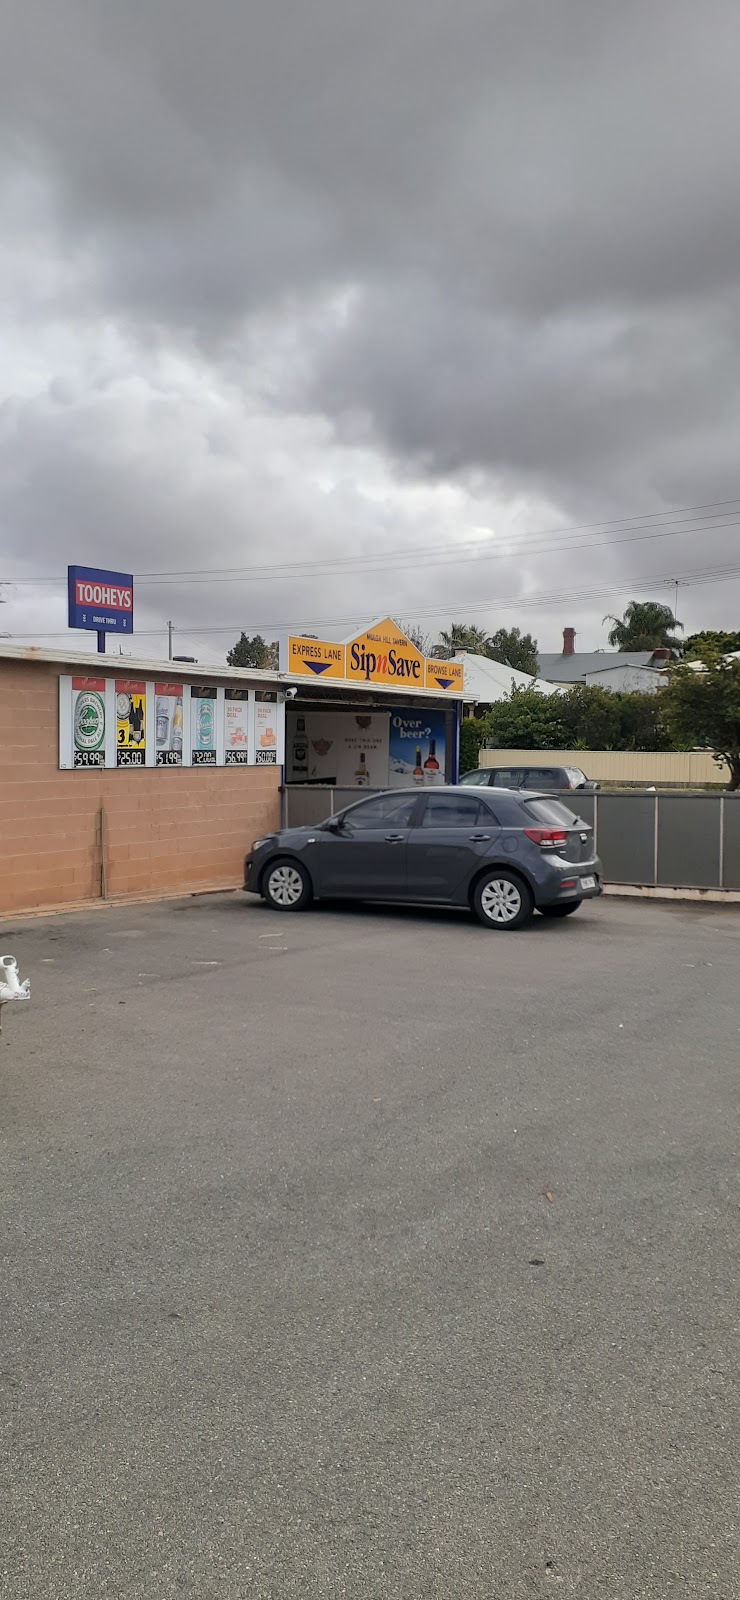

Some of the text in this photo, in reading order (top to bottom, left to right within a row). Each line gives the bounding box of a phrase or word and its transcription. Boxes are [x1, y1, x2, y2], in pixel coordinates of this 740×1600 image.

[77, 583, 131, 608] TOOHEYS
[93, 616, 116, 625] DRIVE THRU
[366, 633, 408, 647] MULGA HILL TAVERN
[292, 643, 342, 661] EXPRESS LANE
[427, 664, 462, 678] BROWSE LANE
[392, 716, 422, 728] Over
[117, 729, 126, 743] 3
[400, 727, 432, 739] beer?
[117, 751, 142, 765] $25.00
